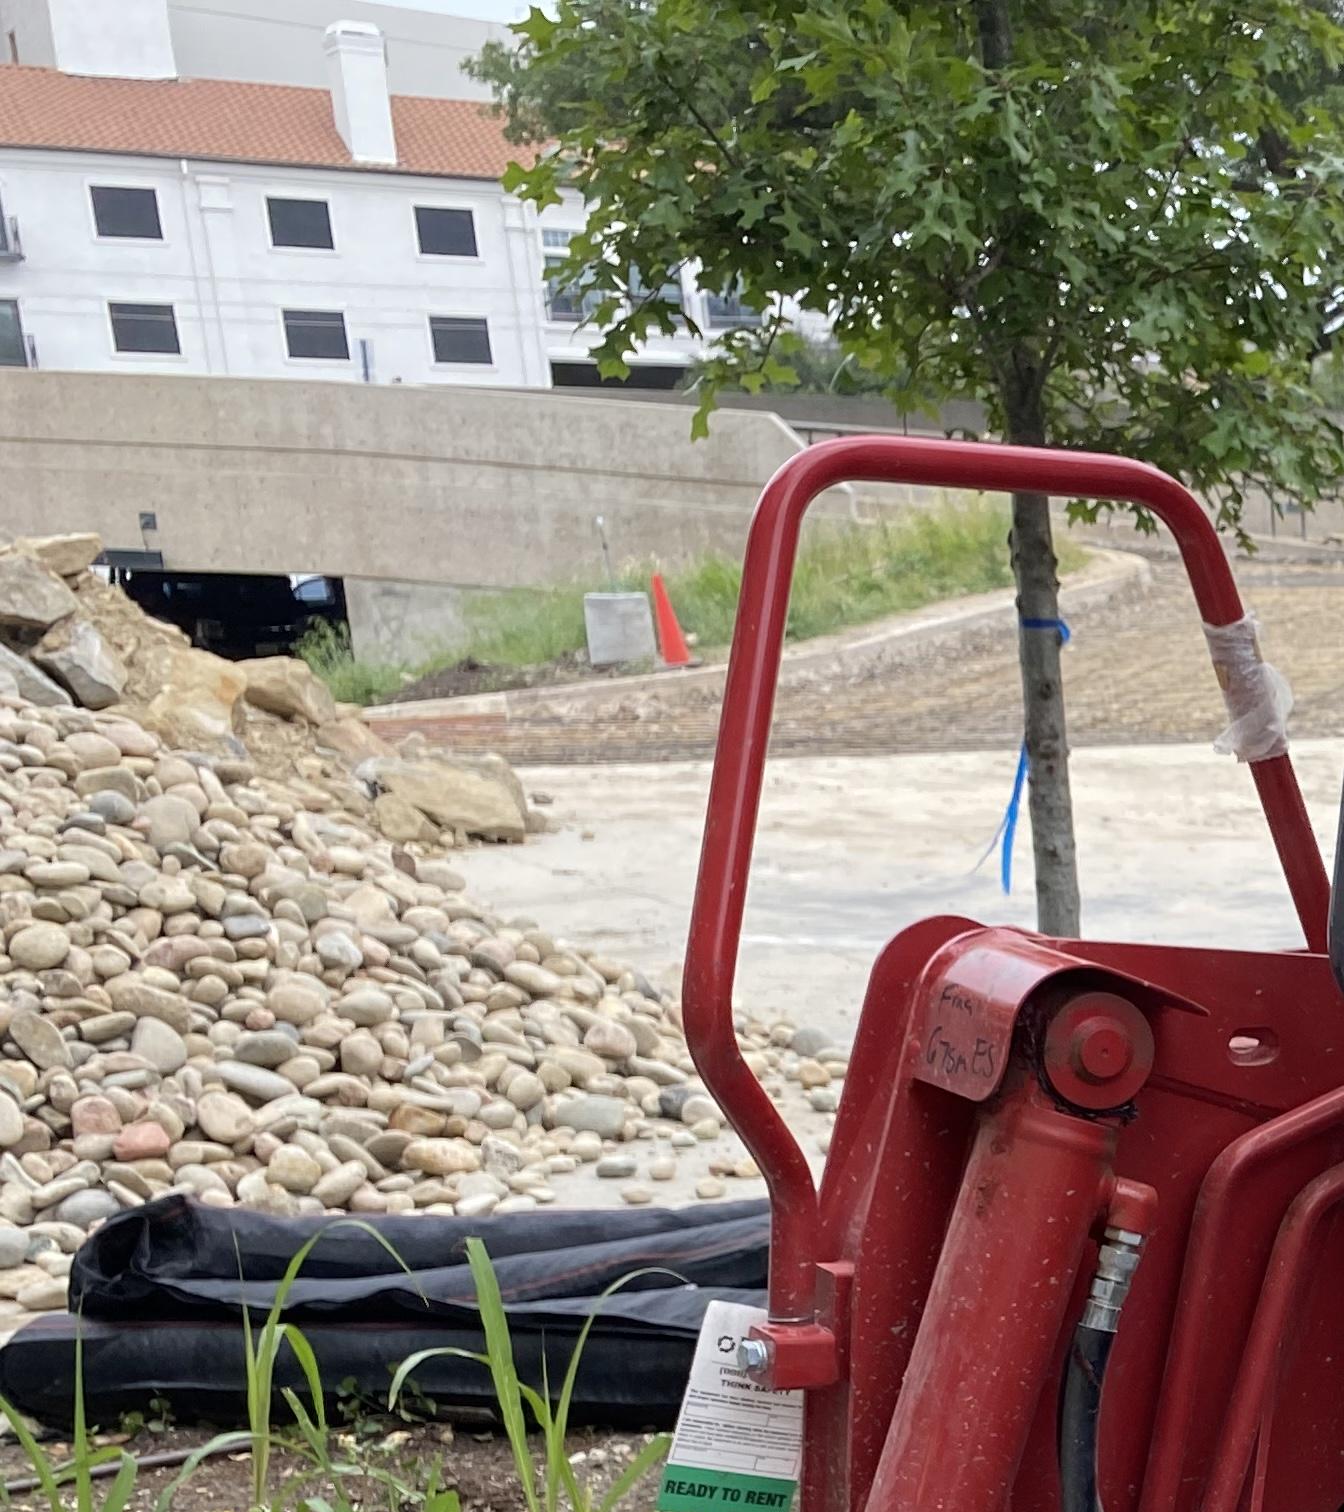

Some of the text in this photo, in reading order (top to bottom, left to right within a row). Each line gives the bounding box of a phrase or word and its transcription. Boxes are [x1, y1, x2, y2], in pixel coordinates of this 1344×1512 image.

[722, 1379, 752, 1390] THINK
[664, 1480, 788, 1508] READY TO RENT
